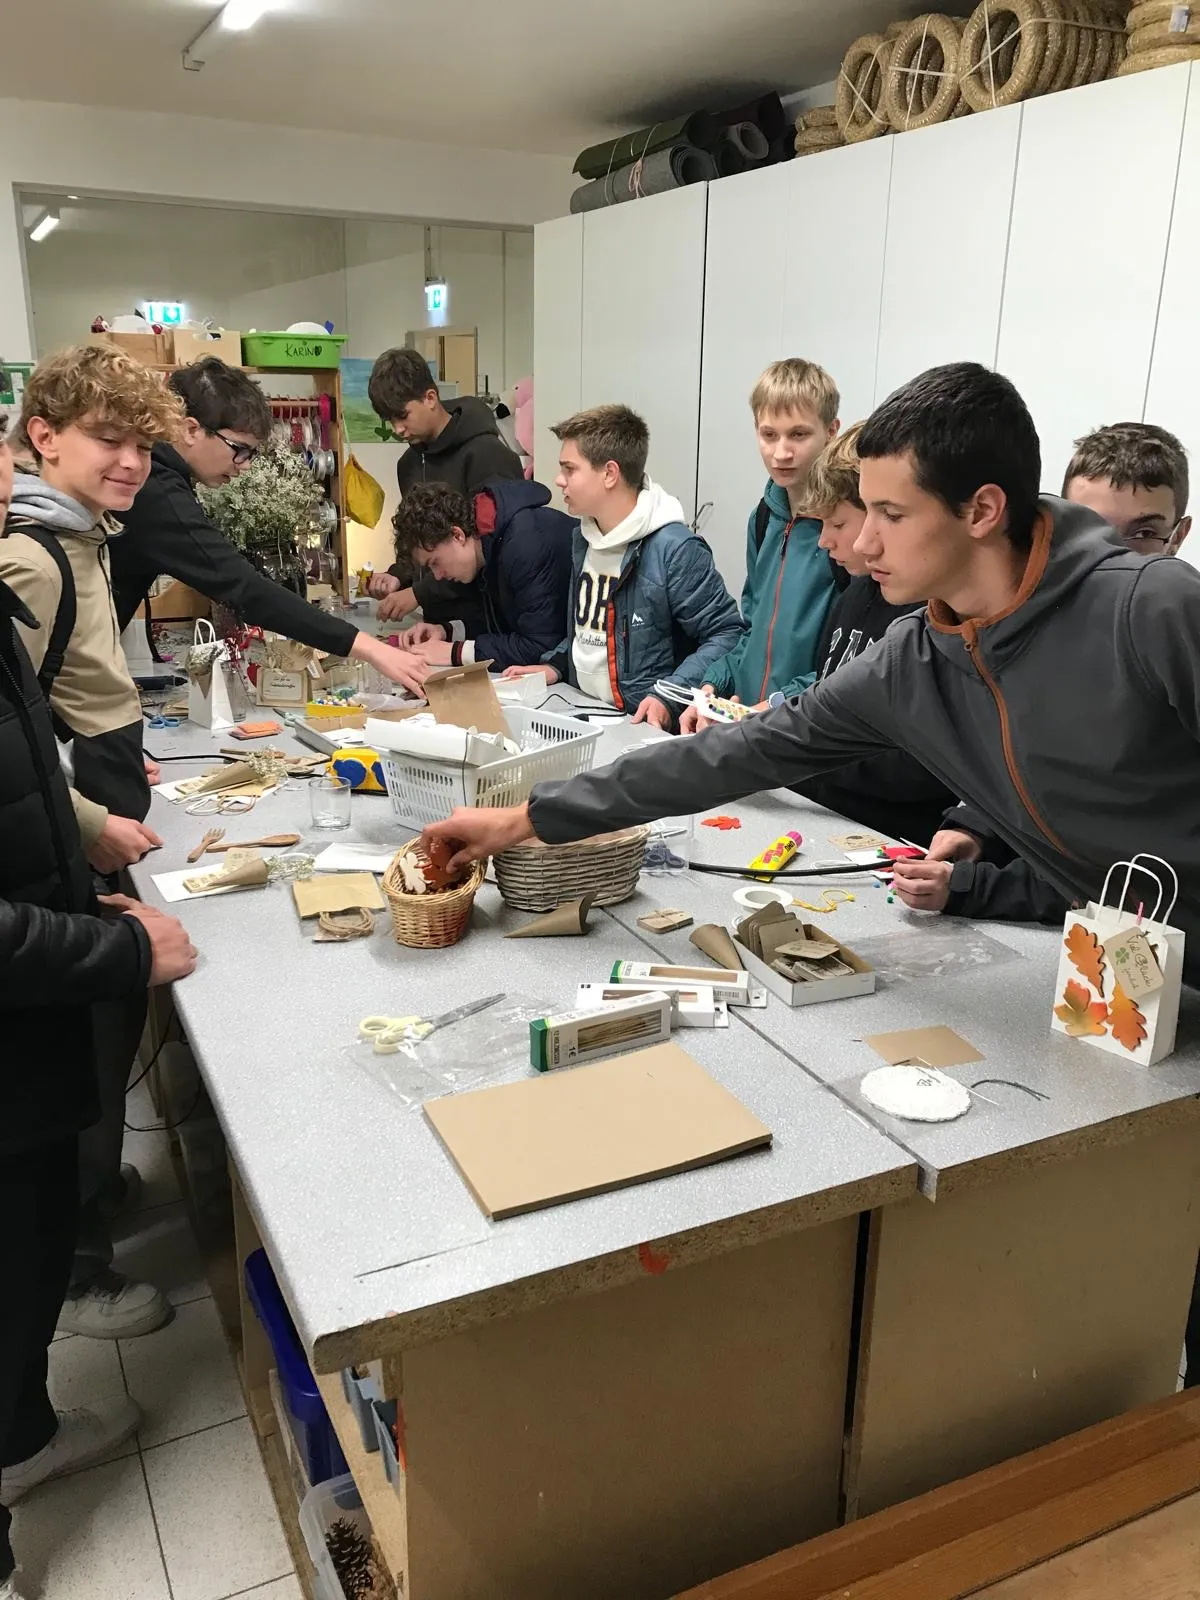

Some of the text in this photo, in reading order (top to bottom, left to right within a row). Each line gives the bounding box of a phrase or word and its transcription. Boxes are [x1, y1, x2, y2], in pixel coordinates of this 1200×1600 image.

[285, 343, 313, 357] KARIN
[576, 571, 619, 631] OH
[784, 840, 796, 852] UHU
